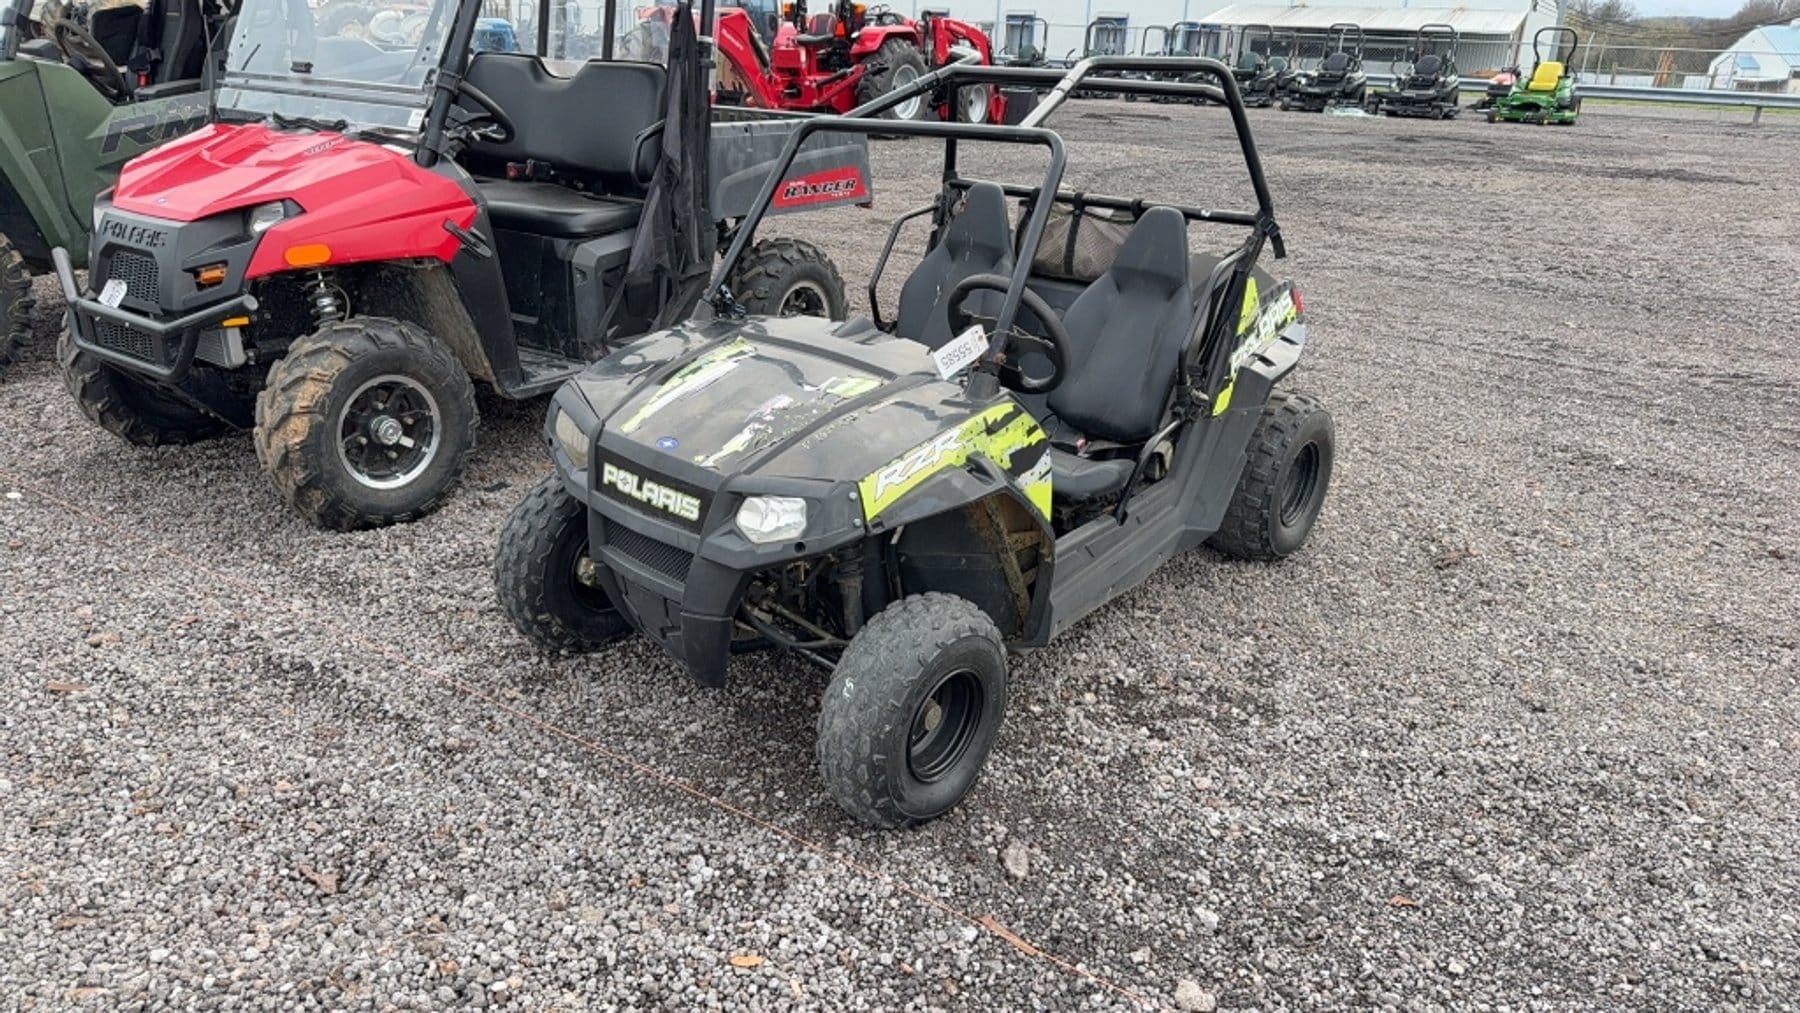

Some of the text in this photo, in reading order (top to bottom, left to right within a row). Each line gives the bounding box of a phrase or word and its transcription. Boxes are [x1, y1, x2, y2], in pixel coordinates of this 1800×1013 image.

[782, 178, 857, 199] RANGER
[102, 220, 168, 248] POLARIS
[1229, 288, 1294, 378] POLARIS
[940, 342, 973, 370] 55585
[874, 426, 967, 503] RZR
[603, 462, 701, 522] POLARIS
